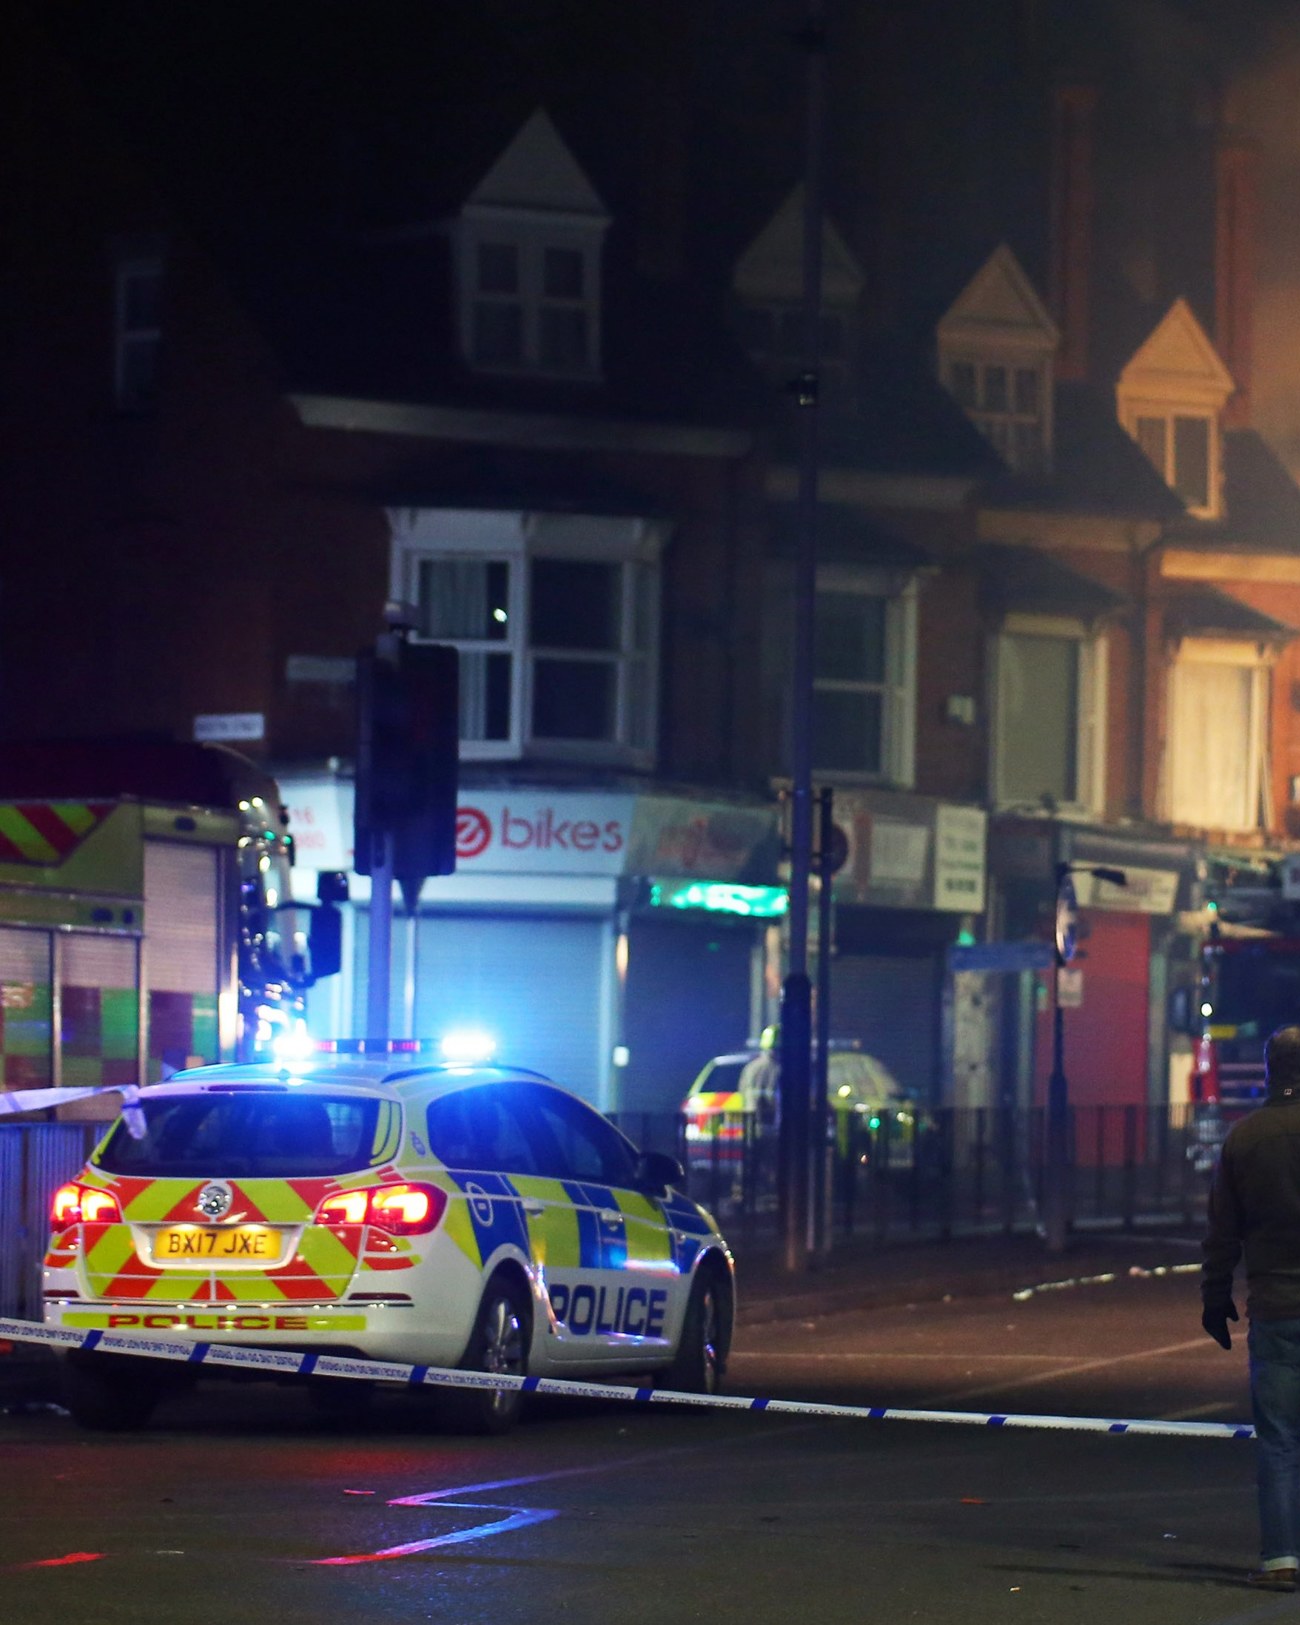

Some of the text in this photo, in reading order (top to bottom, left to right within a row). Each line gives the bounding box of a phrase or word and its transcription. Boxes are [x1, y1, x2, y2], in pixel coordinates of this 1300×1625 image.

[502, 806, 623, 852] bikes
[168, 1233, 268, 1254] BX17 JXE
[108, 1313, 309, 1331] POLICE
[548, 1283, 667, 1337] POLICE
